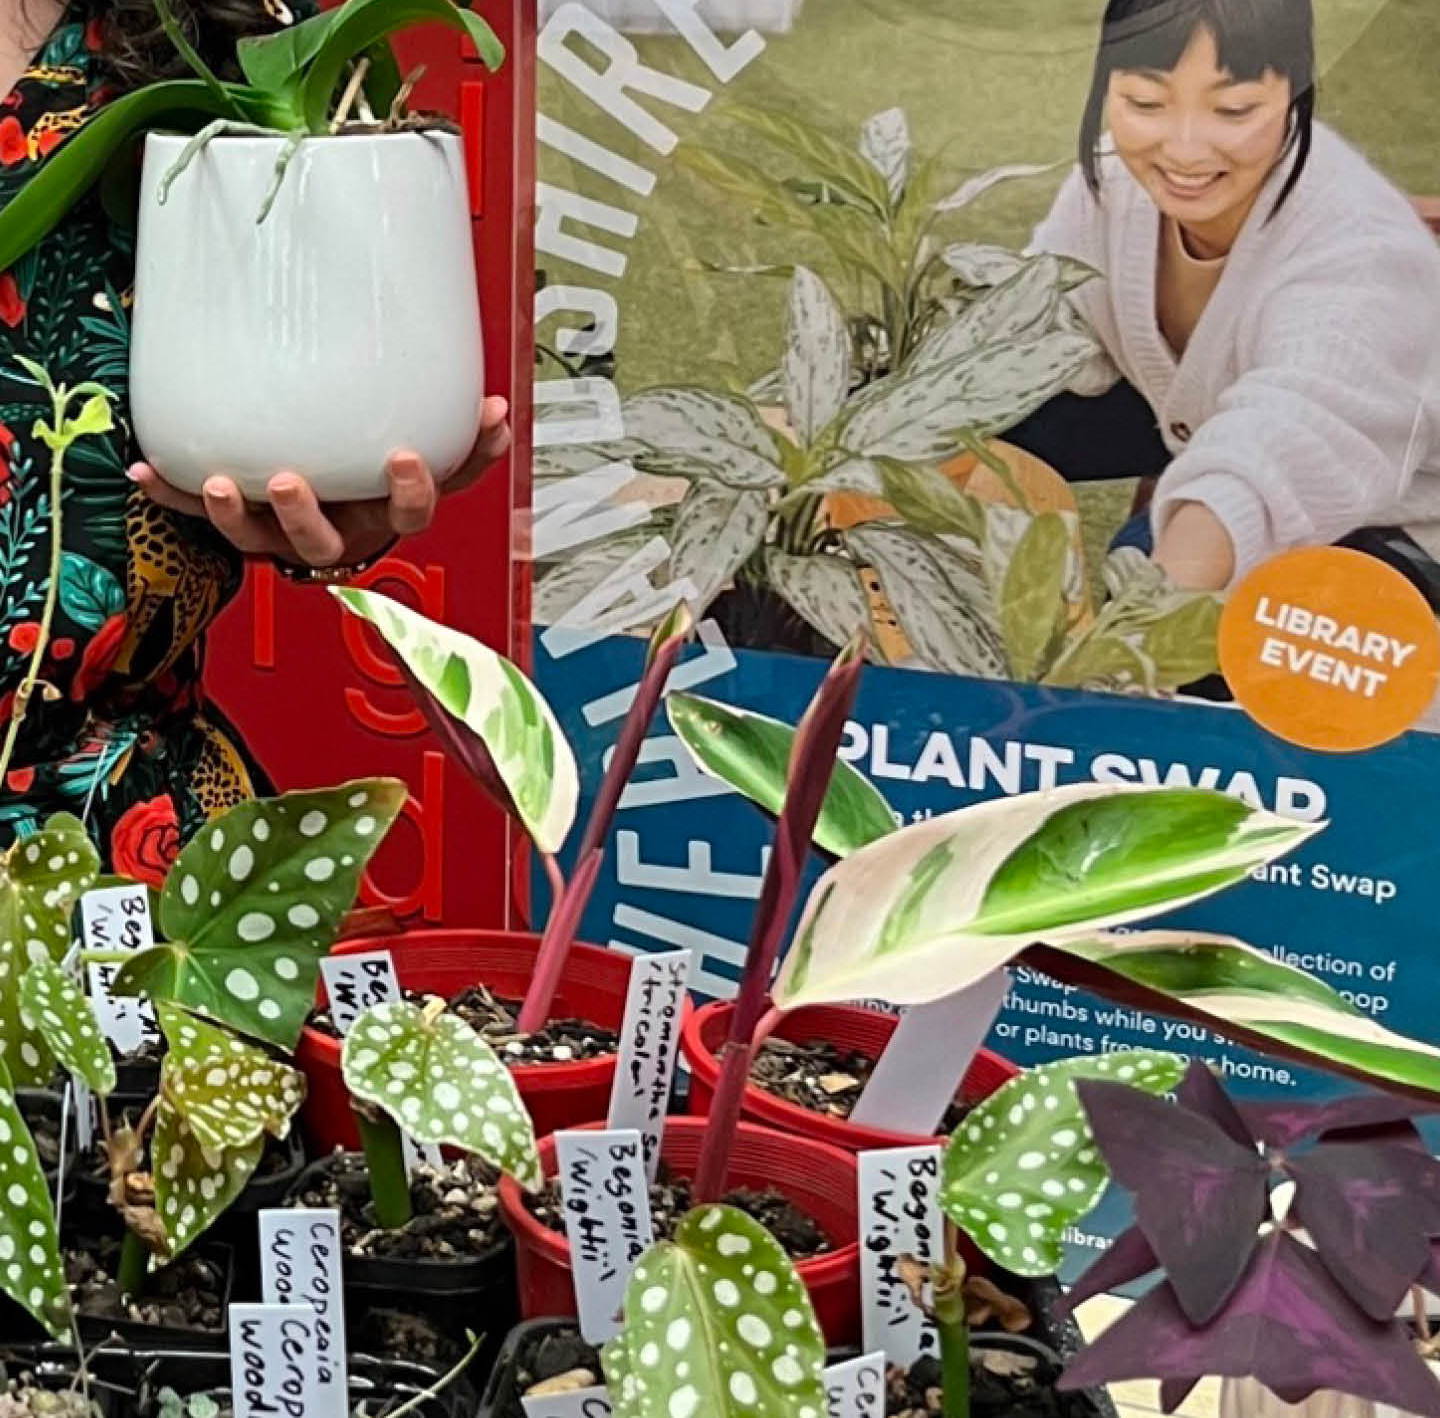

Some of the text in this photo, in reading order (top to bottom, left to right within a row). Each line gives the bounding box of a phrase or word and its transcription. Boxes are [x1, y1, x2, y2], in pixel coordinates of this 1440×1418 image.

[1254, 596, 1417, 668] LIBRARY
[1260, 637, 1388, 698] EVENT
[1252, 862, 1398, 904] ant Swap
[1260, 943, 1398, 982] llection of
[1003, 990, 1208, 1042] thumbs while you
[995, 1022, 1021, 1039] or
[1024, 1023, 1095, 1053] plants
[1221, 1053, 1298, 1087] home.
[604, 1144, 647, 1263] Begonia
[240, 1320, 279, 1418] wood
